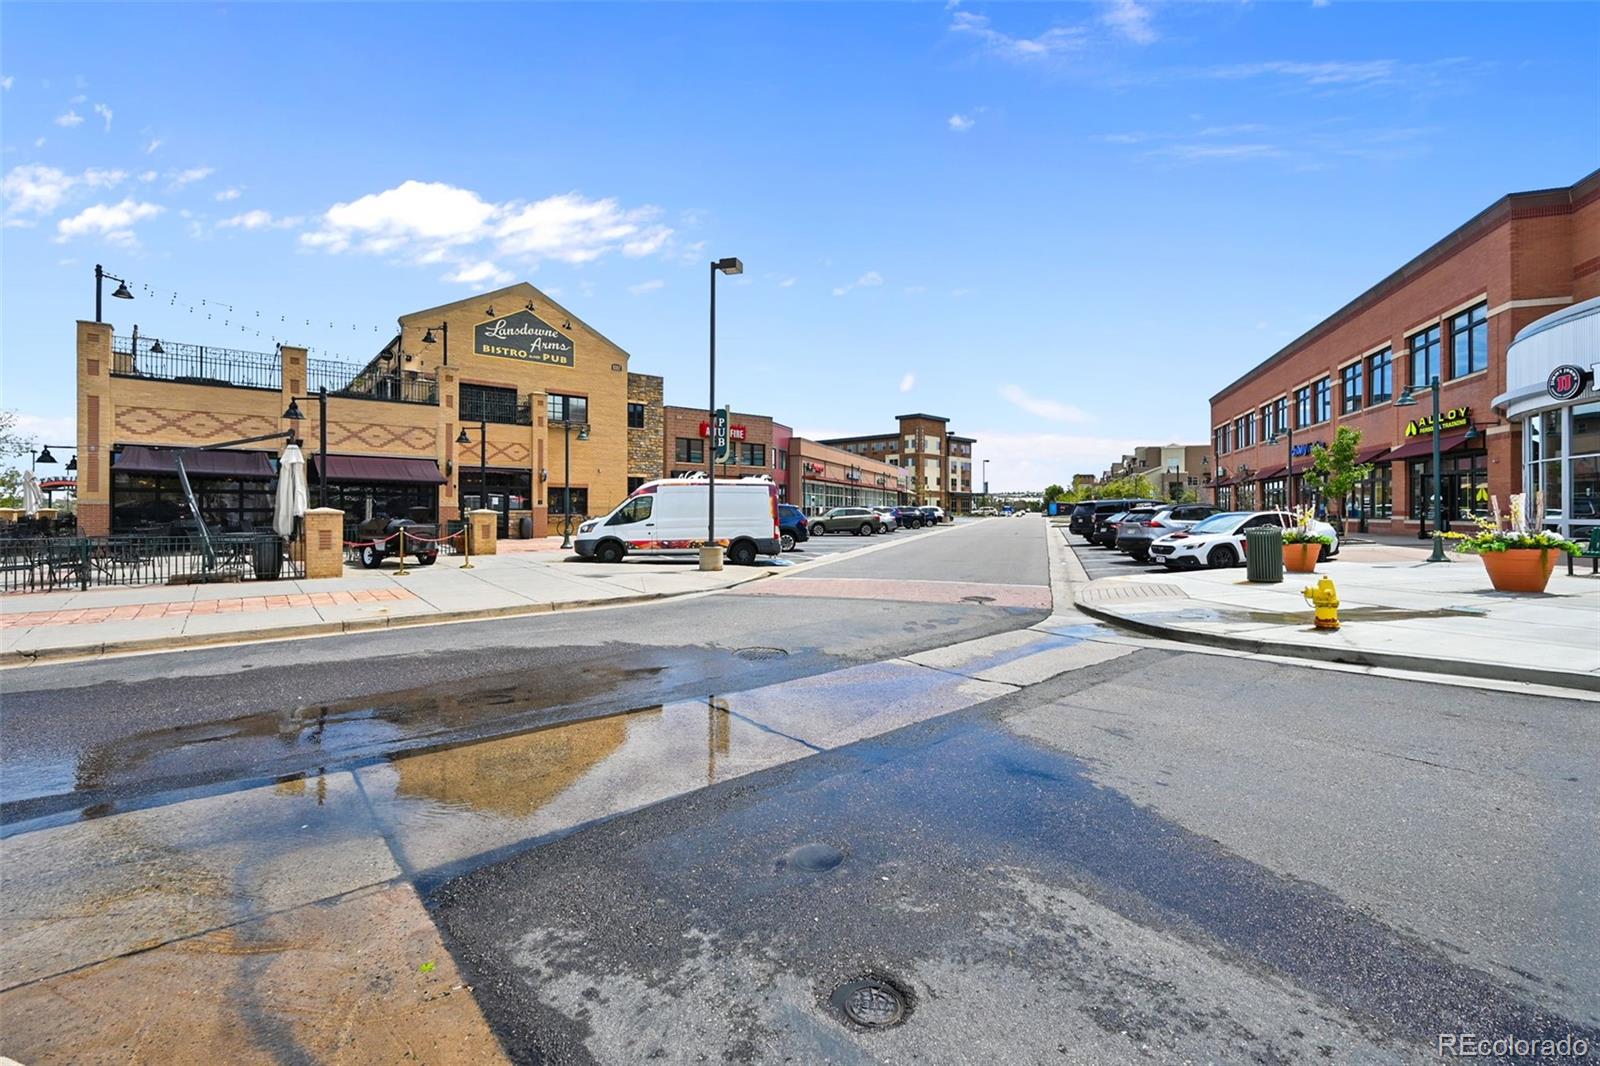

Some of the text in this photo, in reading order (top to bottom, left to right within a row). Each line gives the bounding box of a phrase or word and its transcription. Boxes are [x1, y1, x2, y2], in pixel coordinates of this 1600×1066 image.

[484, 319, 559, 339] Lansdowne
[482, 344, 528, 358] BISTRO
[542, 353, 568, 364] PUB
[530, 337, 571, 353] Arms
[1419, 407, 1467, 426] ALLOY
[717, 417, 726, 447] PUB
[730, 428, 745, 439] FIRE
